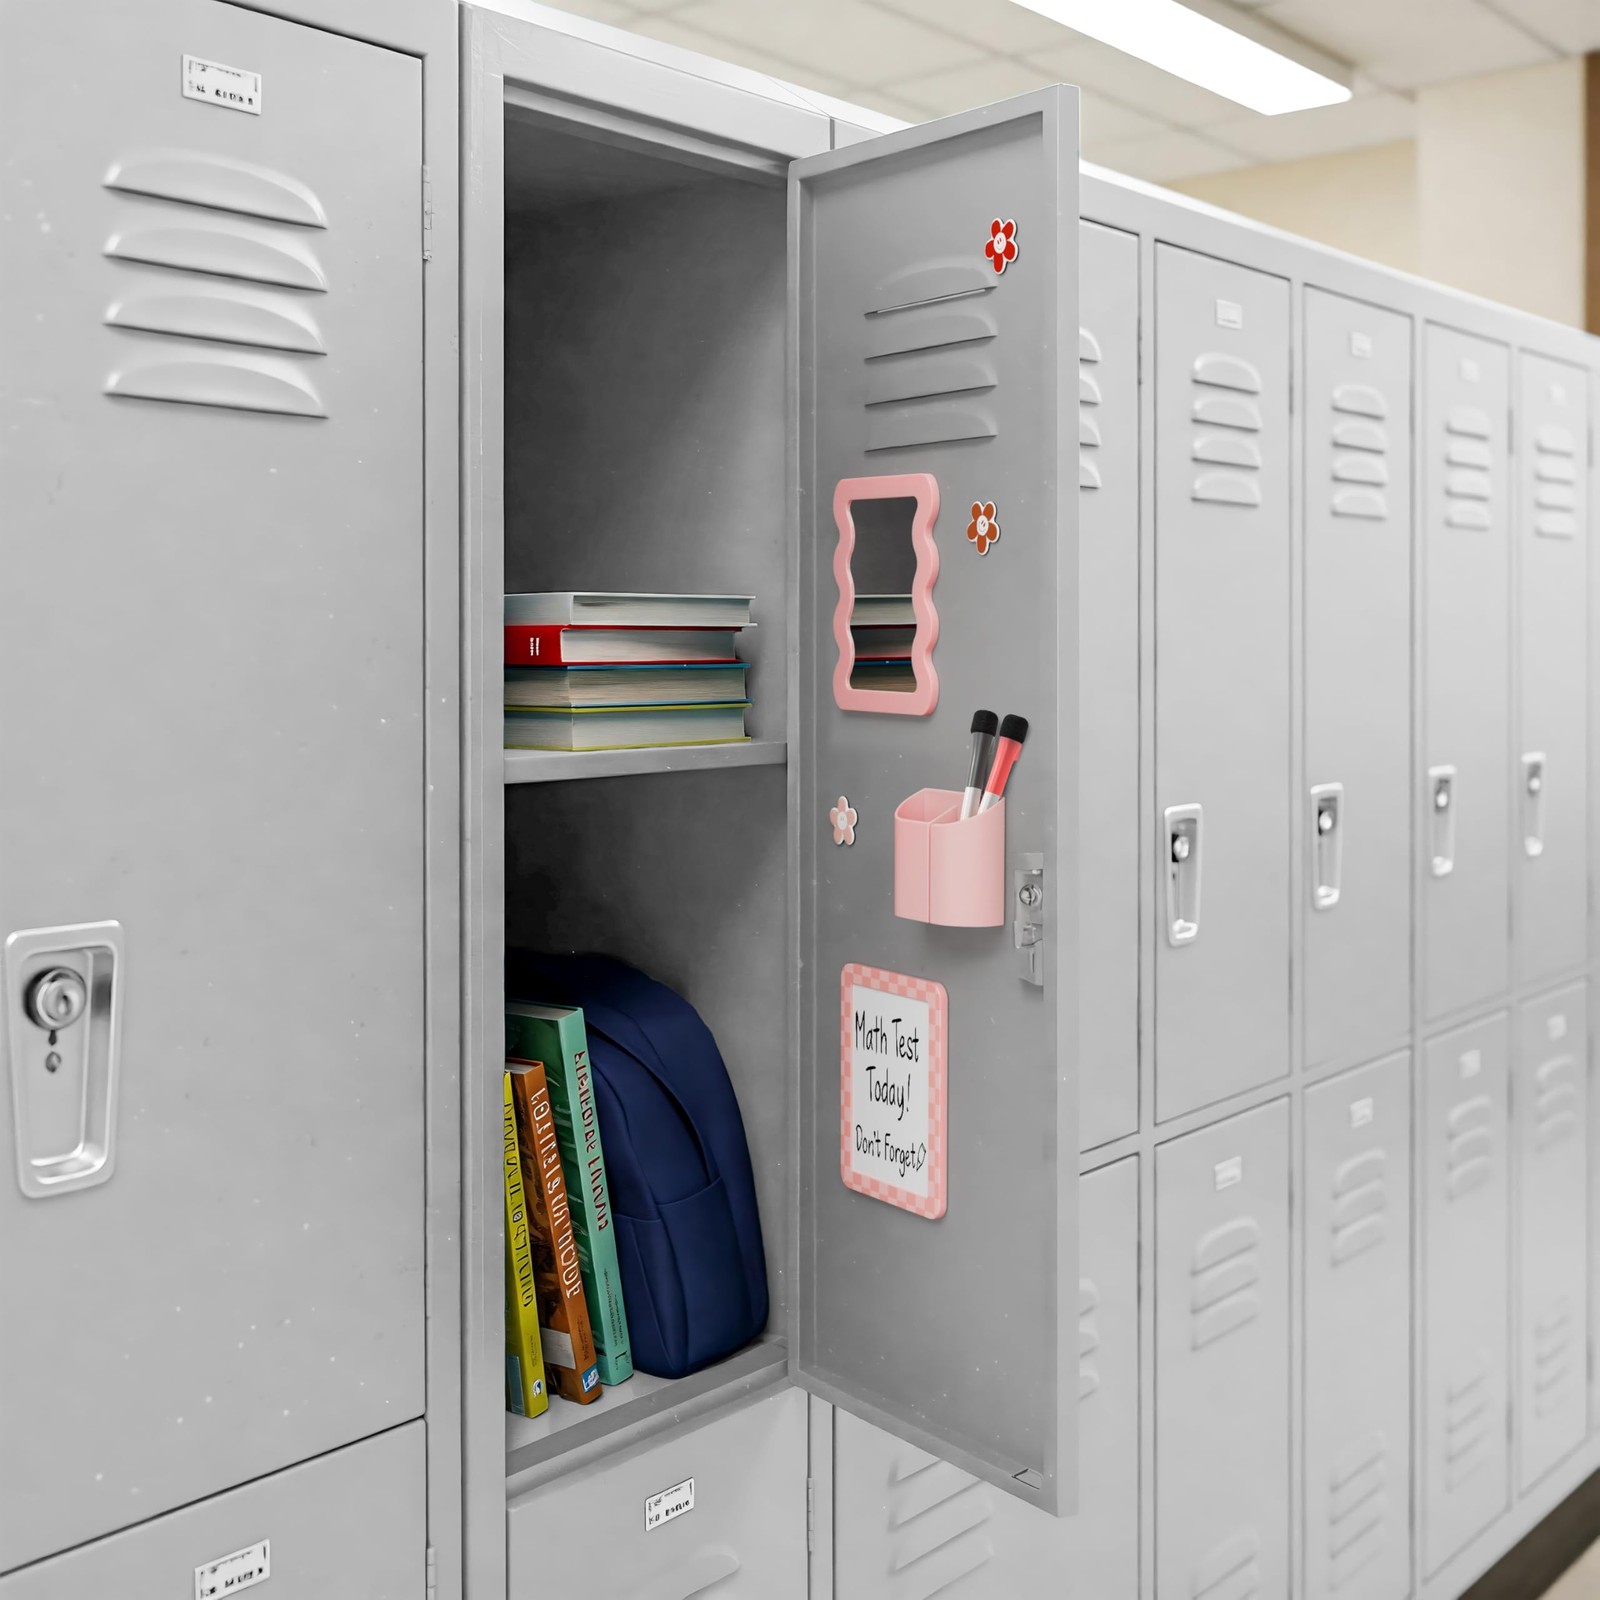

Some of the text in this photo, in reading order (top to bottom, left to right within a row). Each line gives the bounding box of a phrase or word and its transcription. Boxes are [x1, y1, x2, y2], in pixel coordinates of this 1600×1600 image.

[855, 1010, 920, 1063] Math Test
[865, 1065, 911, 1121] Today!
[855, 1124, 917, 1178] Don't Forget
